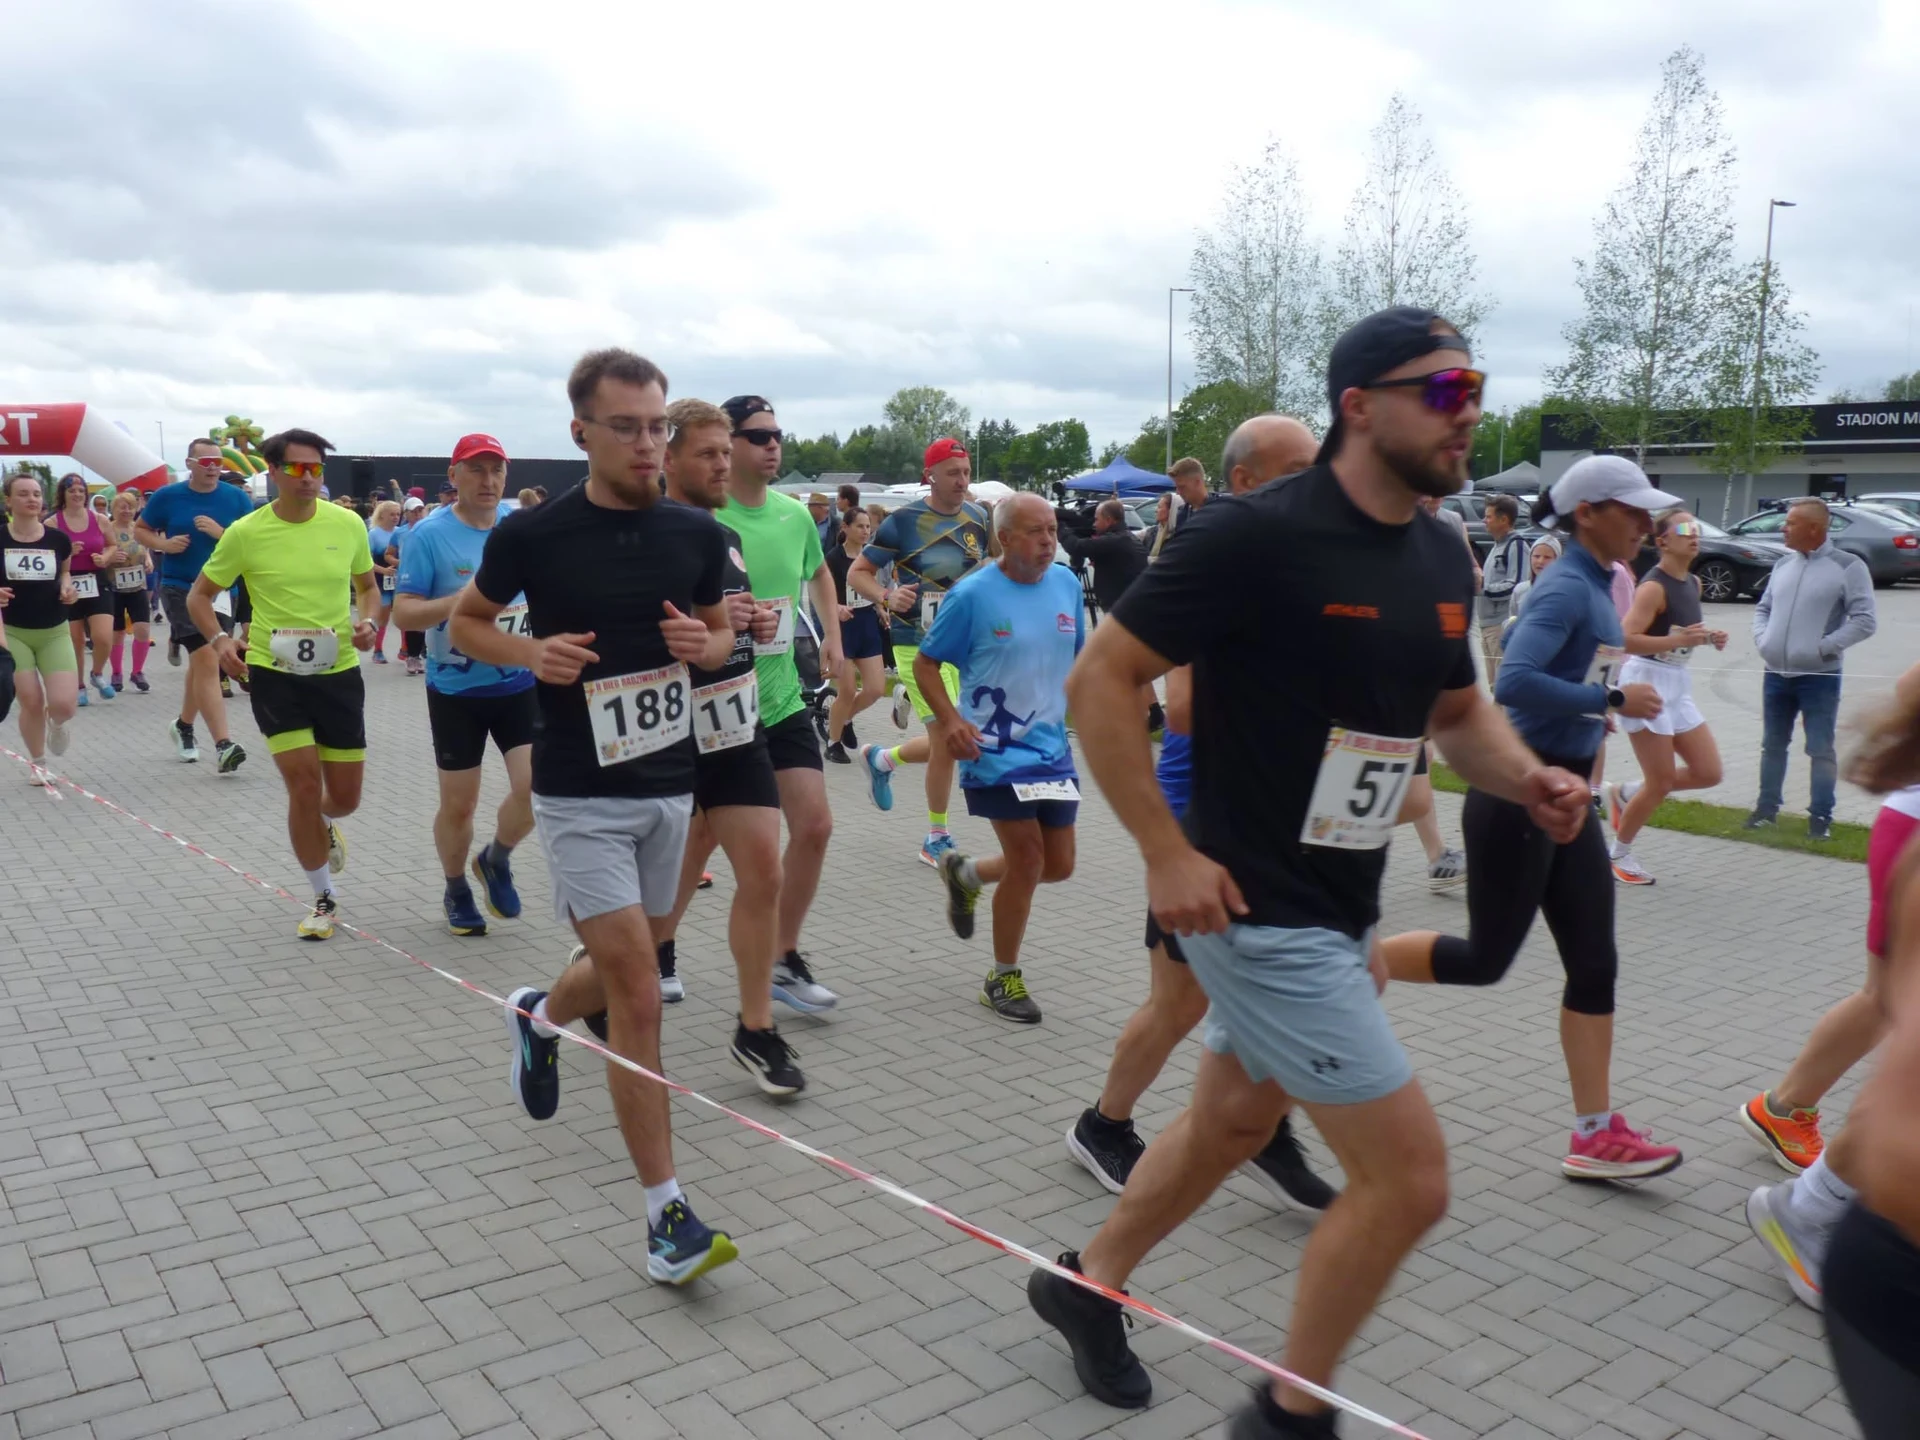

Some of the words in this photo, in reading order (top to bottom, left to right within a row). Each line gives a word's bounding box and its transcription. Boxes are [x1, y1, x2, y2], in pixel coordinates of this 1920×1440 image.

[1836, 412, 1899, 427] STADION
[17, 555, 45, 571] 46
[119, 569, 143, 583] 111
[297, 638, 315, 663] 8
[603, 681, 684, 737] 188
[1348, 760, 1409, 818] 57
